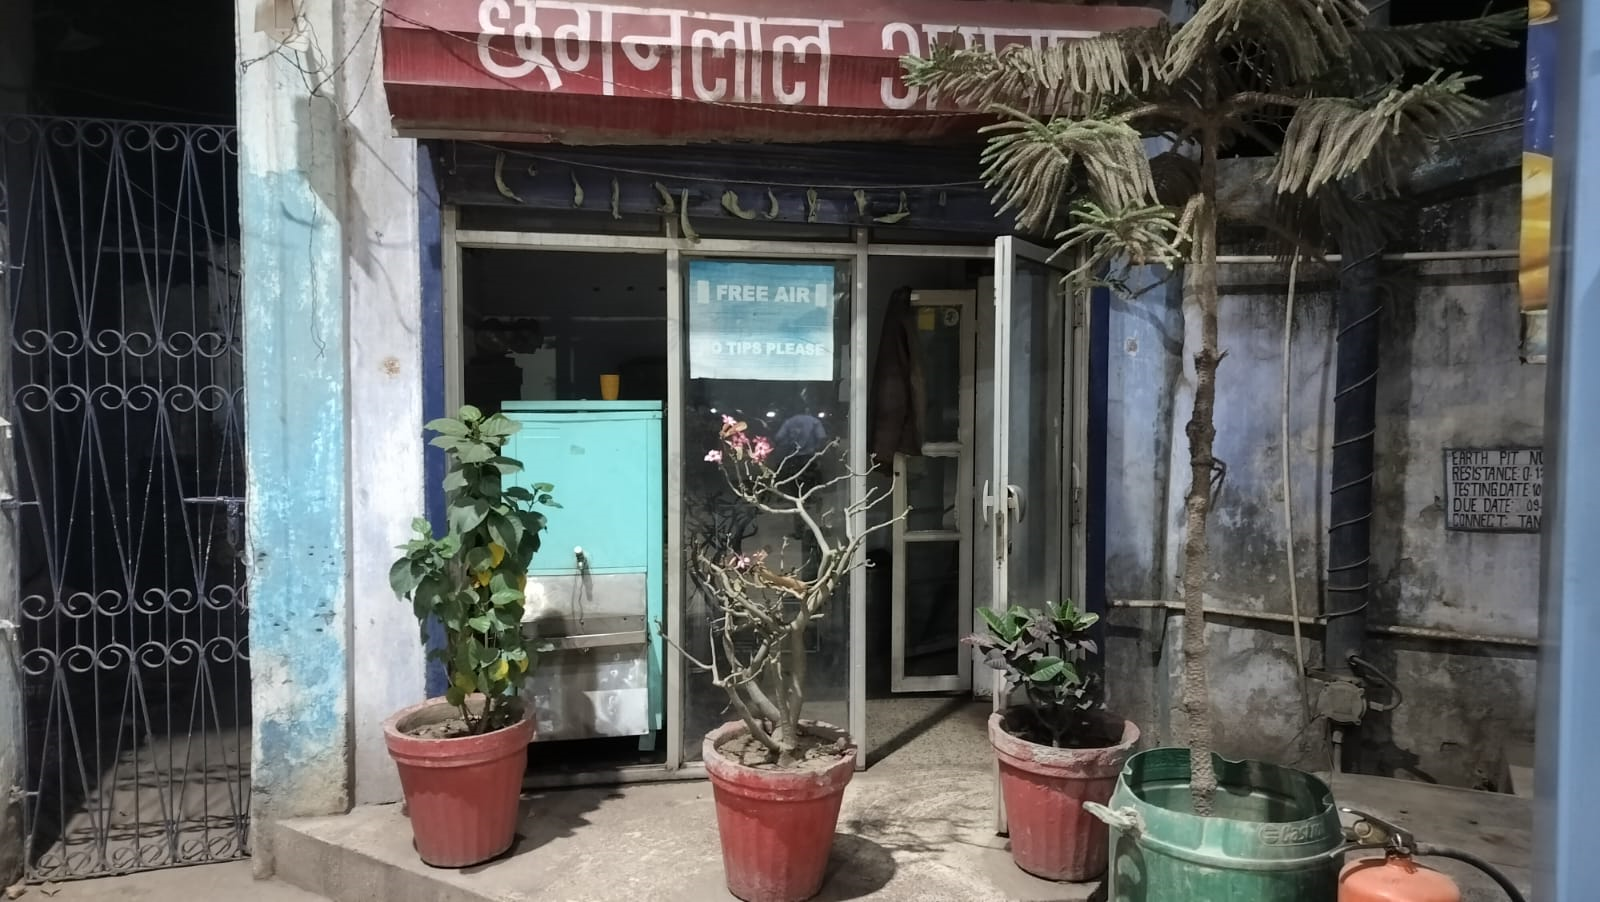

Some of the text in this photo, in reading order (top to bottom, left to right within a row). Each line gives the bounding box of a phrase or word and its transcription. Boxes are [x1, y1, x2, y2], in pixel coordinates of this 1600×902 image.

[716, 284, 811, 303] FREE AIR
[726, 342, 762, 355] TIPS
[766, 342, 826, 356] PLEASE
[1451, 451, 1488, 466] EARTH
[1500, 451, 1520, 466] PIT
[1453, 498, 1477, 513] DUE
